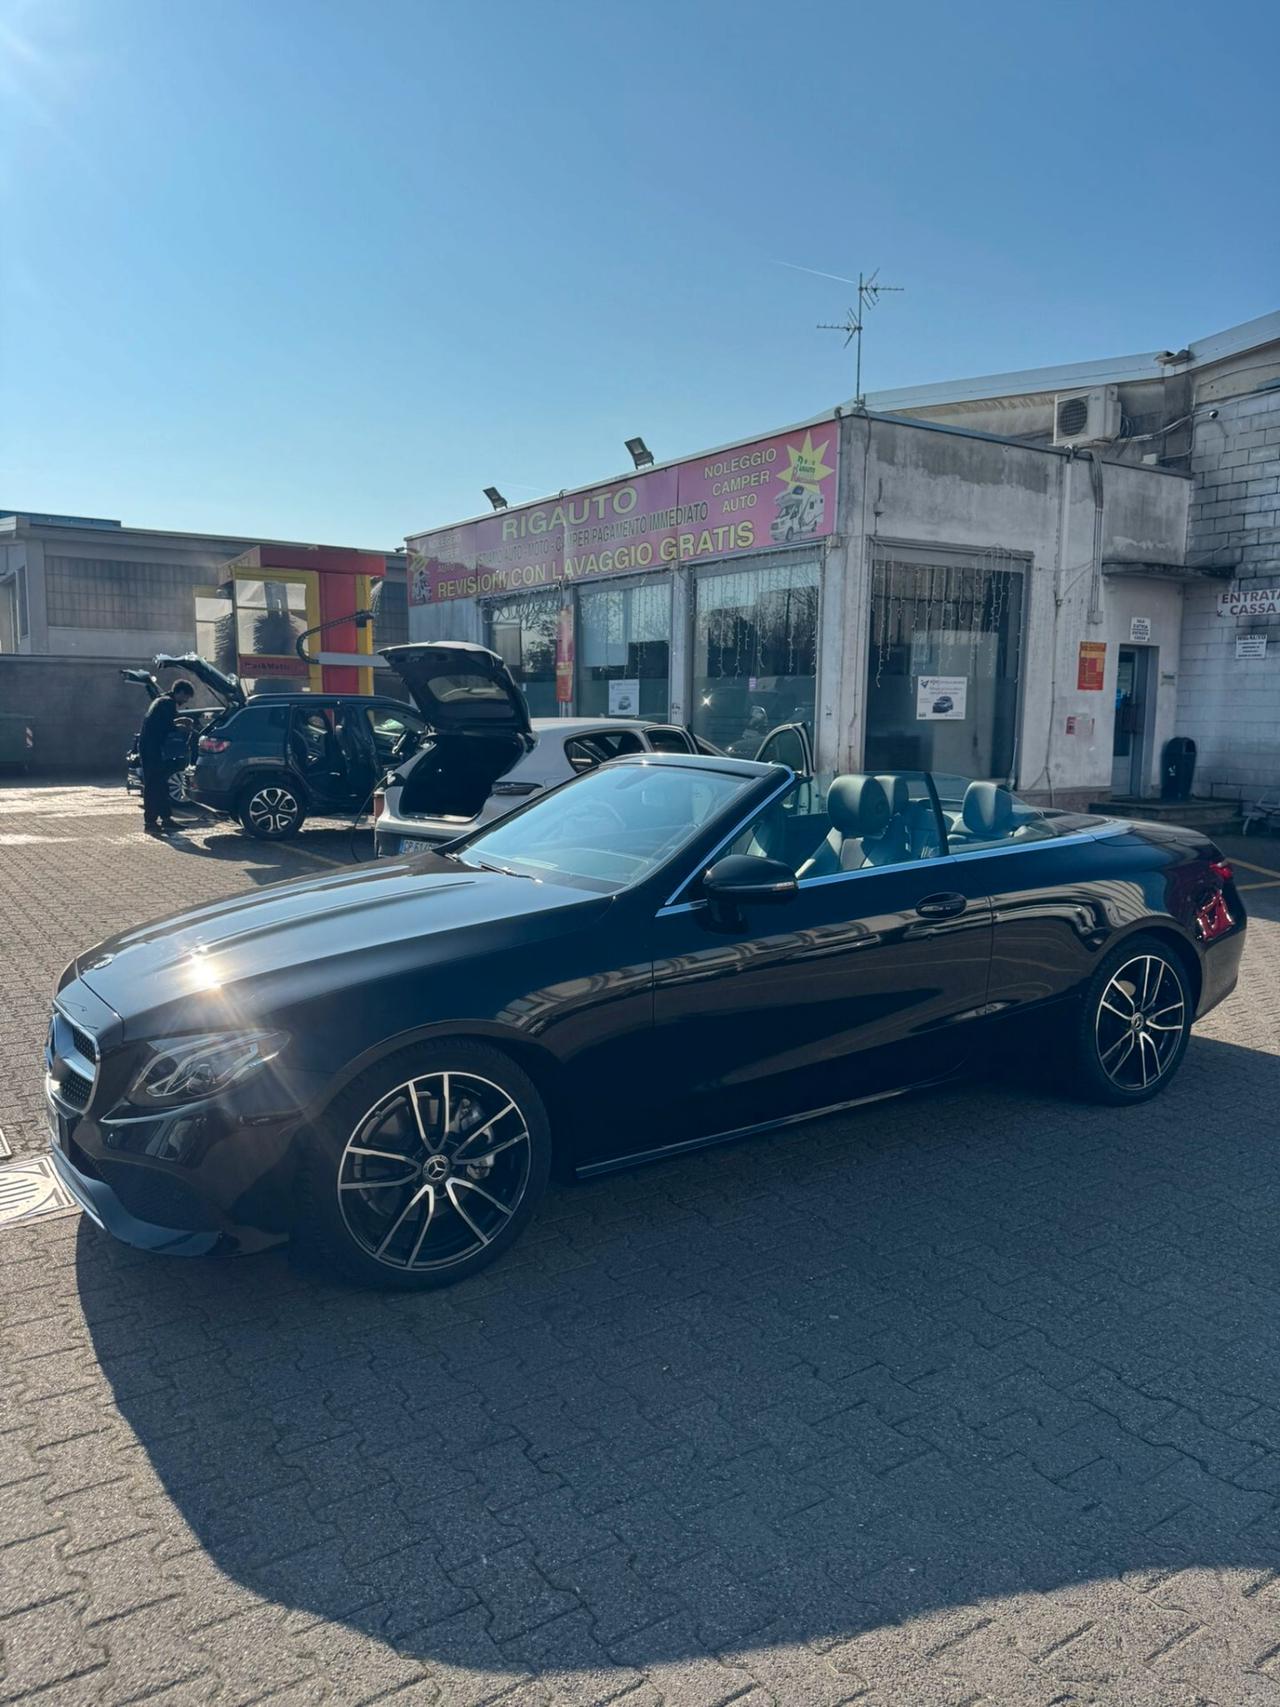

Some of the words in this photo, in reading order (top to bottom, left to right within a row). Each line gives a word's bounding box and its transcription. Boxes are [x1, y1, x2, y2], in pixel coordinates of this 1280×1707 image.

[704, 448, 777, 479] NOLEGGIO
[712, 470, 770, 496] CAMPER
[501, 486, 638, 541] RIGAUTO
[722, 493, 758, 513] AUTO
[592, 516, 647, 545] PAGAMENTO
[649, 501, 709, 531] IMMEDIATO
[511, 563, 546, 587] CON
[552, 542, 653, 579] LAVAGGIO
[659, 521, 755, 561] GRATIS
[1230, 602, 1277, 615] CASSA
